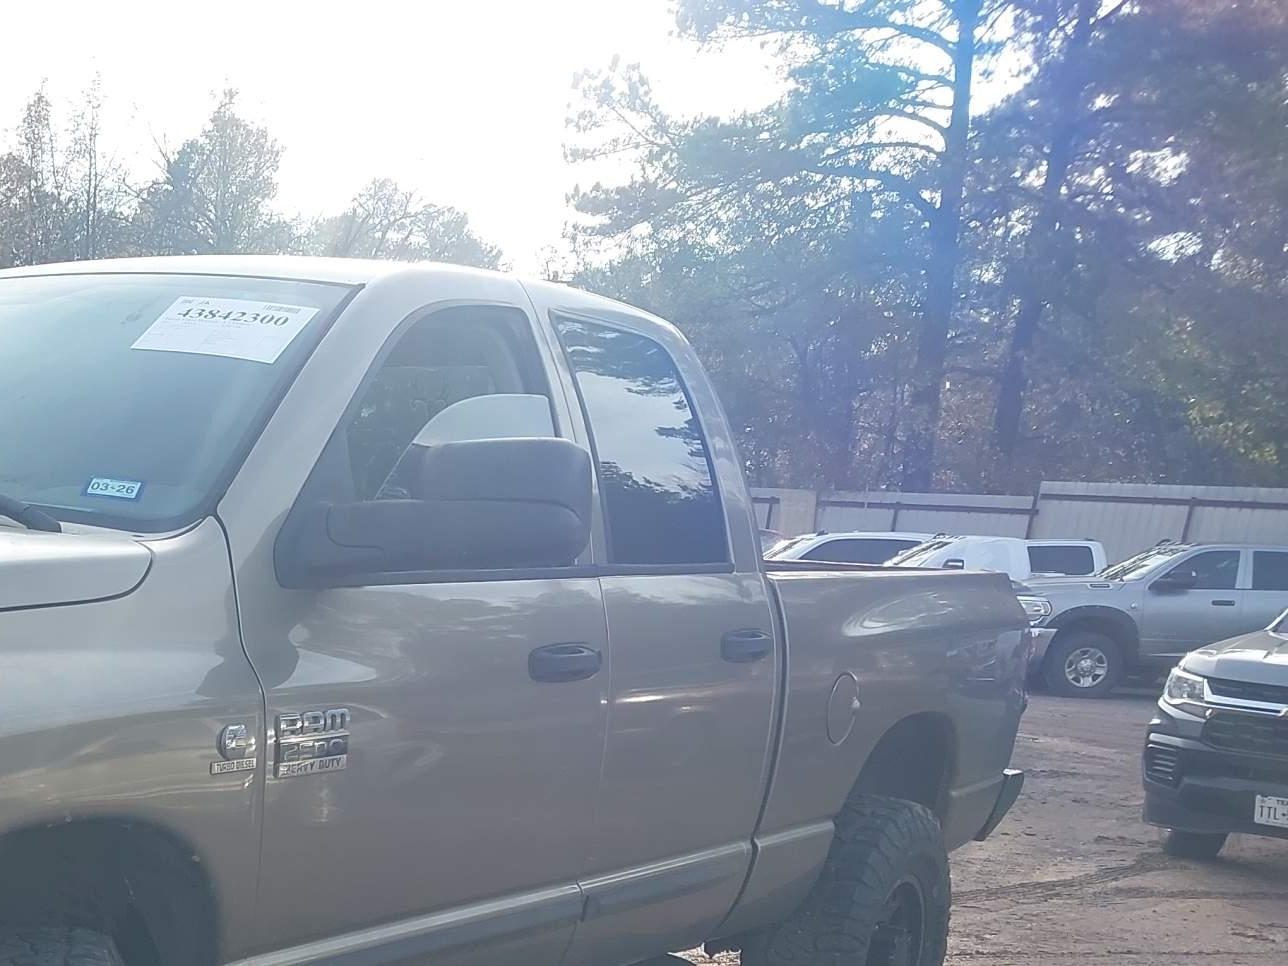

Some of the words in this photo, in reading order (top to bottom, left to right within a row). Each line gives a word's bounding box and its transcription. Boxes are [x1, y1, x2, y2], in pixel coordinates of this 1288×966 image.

[177, 307, 289, 327] 43842300
[91, 481, 136, 495] 03-26
[279, 708, 351, 736] RAM
[282, 759, 315, 777] HEAVY
[318, 756, 342, 770] DUTY
